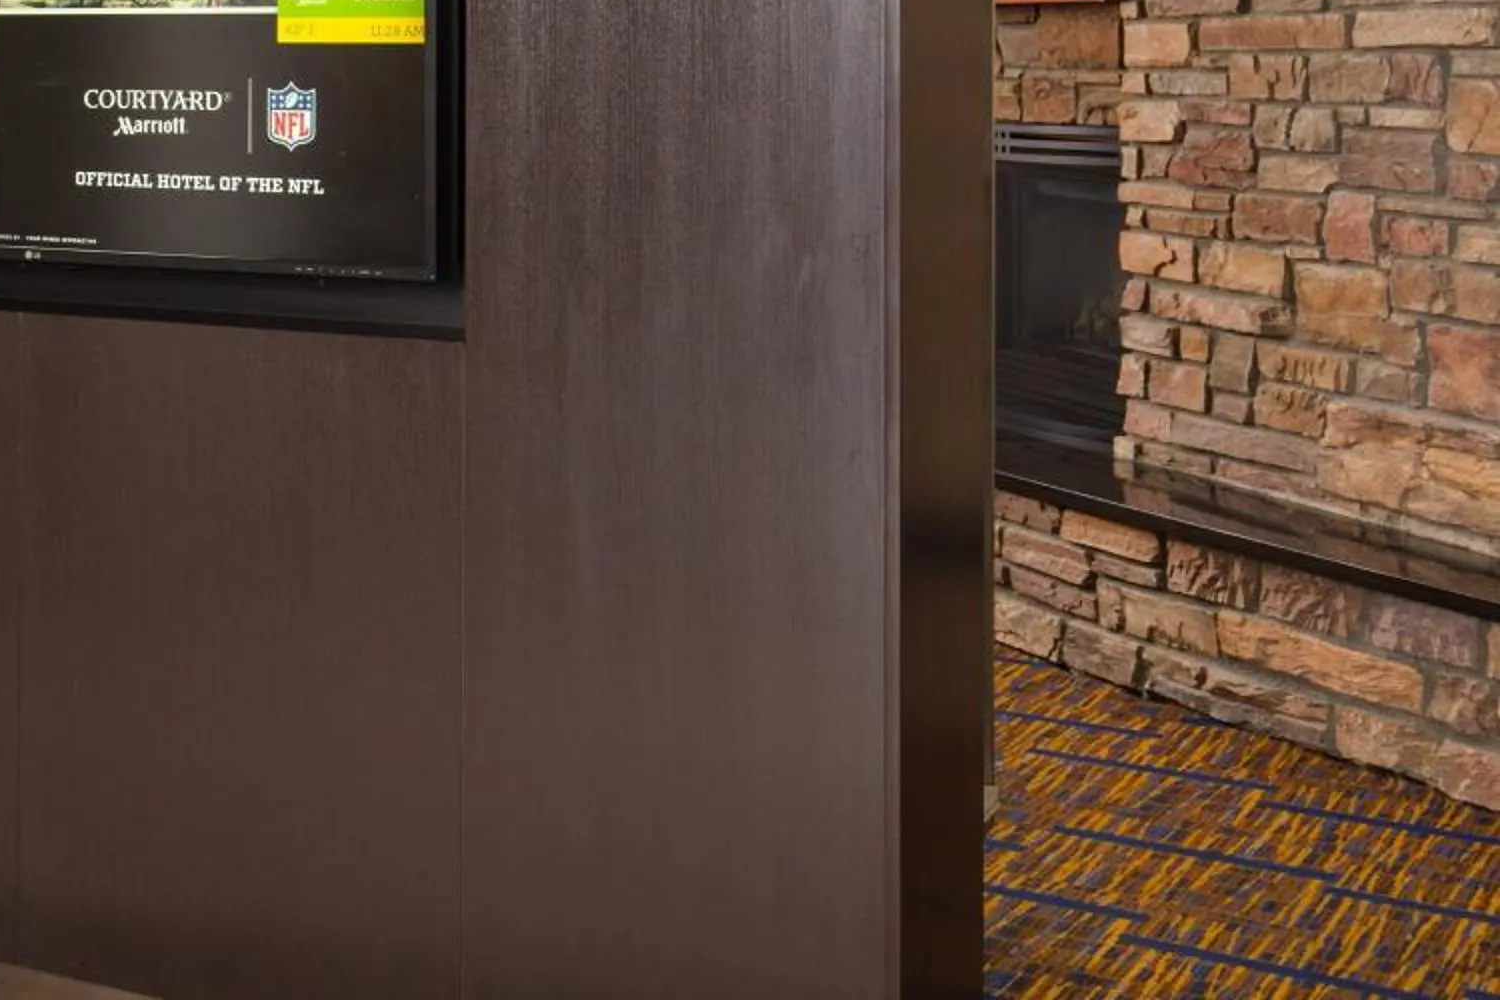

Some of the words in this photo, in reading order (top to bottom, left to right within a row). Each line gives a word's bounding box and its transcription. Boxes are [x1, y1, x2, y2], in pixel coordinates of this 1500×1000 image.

[83, 89, 223, 111] COURTYARD
[113, 116, 186, 136] Marriott
[273, 112, 310, 139] NFL
[75, 171, 153, 189] OFFICIAL
[157, 175, 215, 191] HOTEL
[219, 176, 243, 191] OF
[246, 177, 283, 193] THE
[287, 178, 325, 195] NFL
